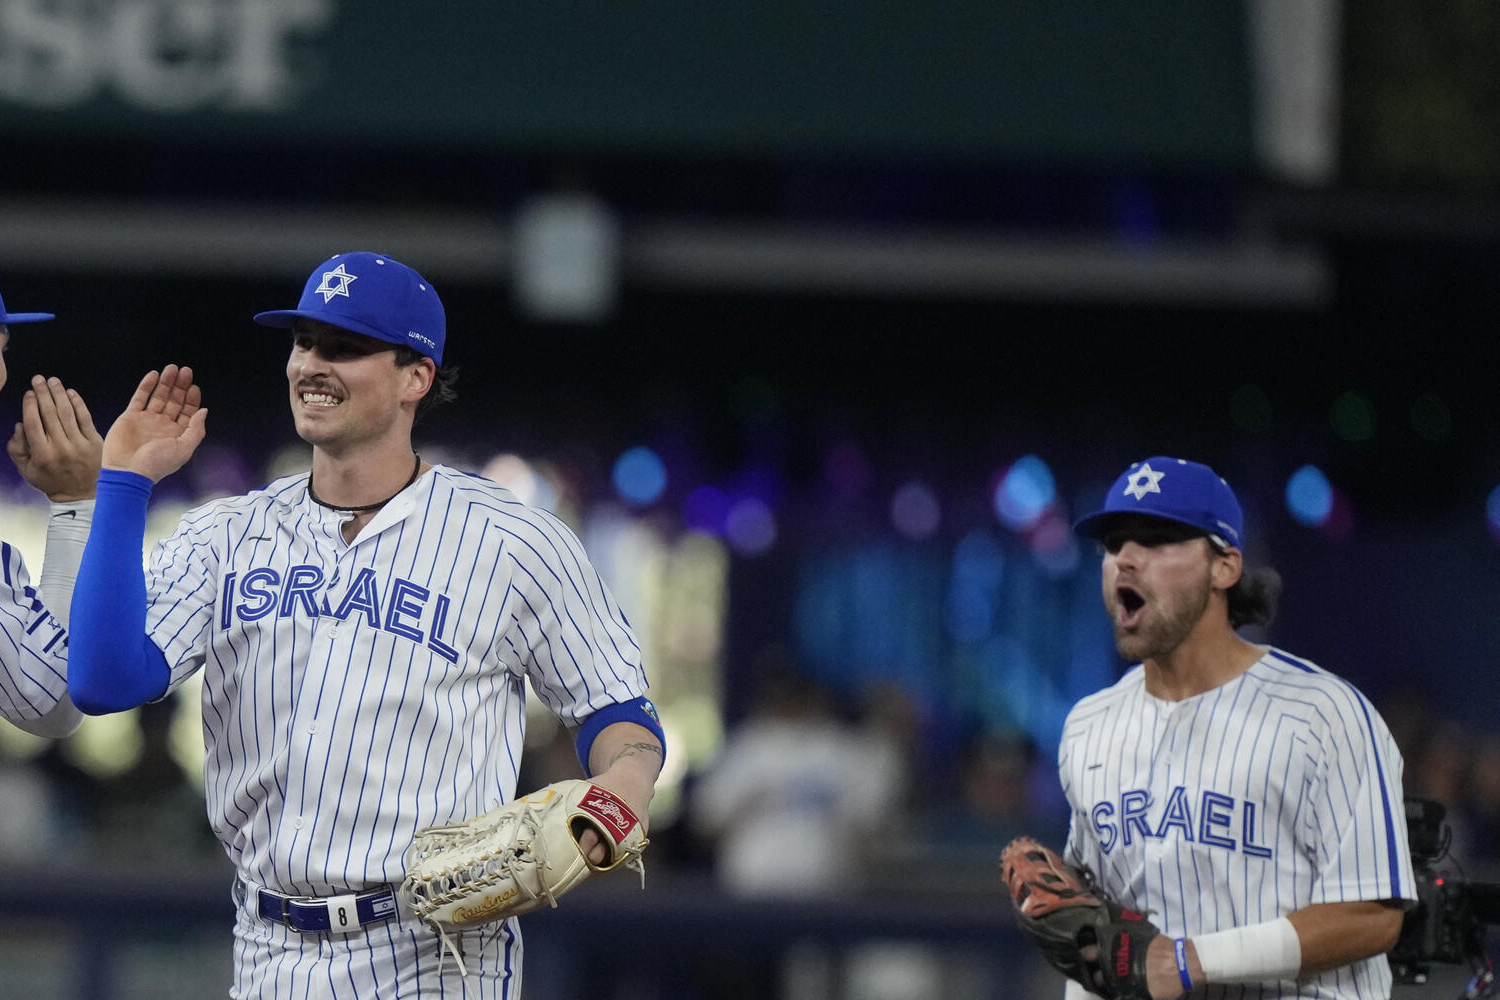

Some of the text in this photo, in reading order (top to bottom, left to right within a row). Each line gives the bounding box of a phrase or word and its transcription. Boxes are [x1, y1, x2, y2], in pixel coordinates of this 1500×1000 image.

[220, 563, 461, 668] ISRAEL
[1090, 785, 1273, 860] SRAEL
[337, 906, 348, 927] 8
